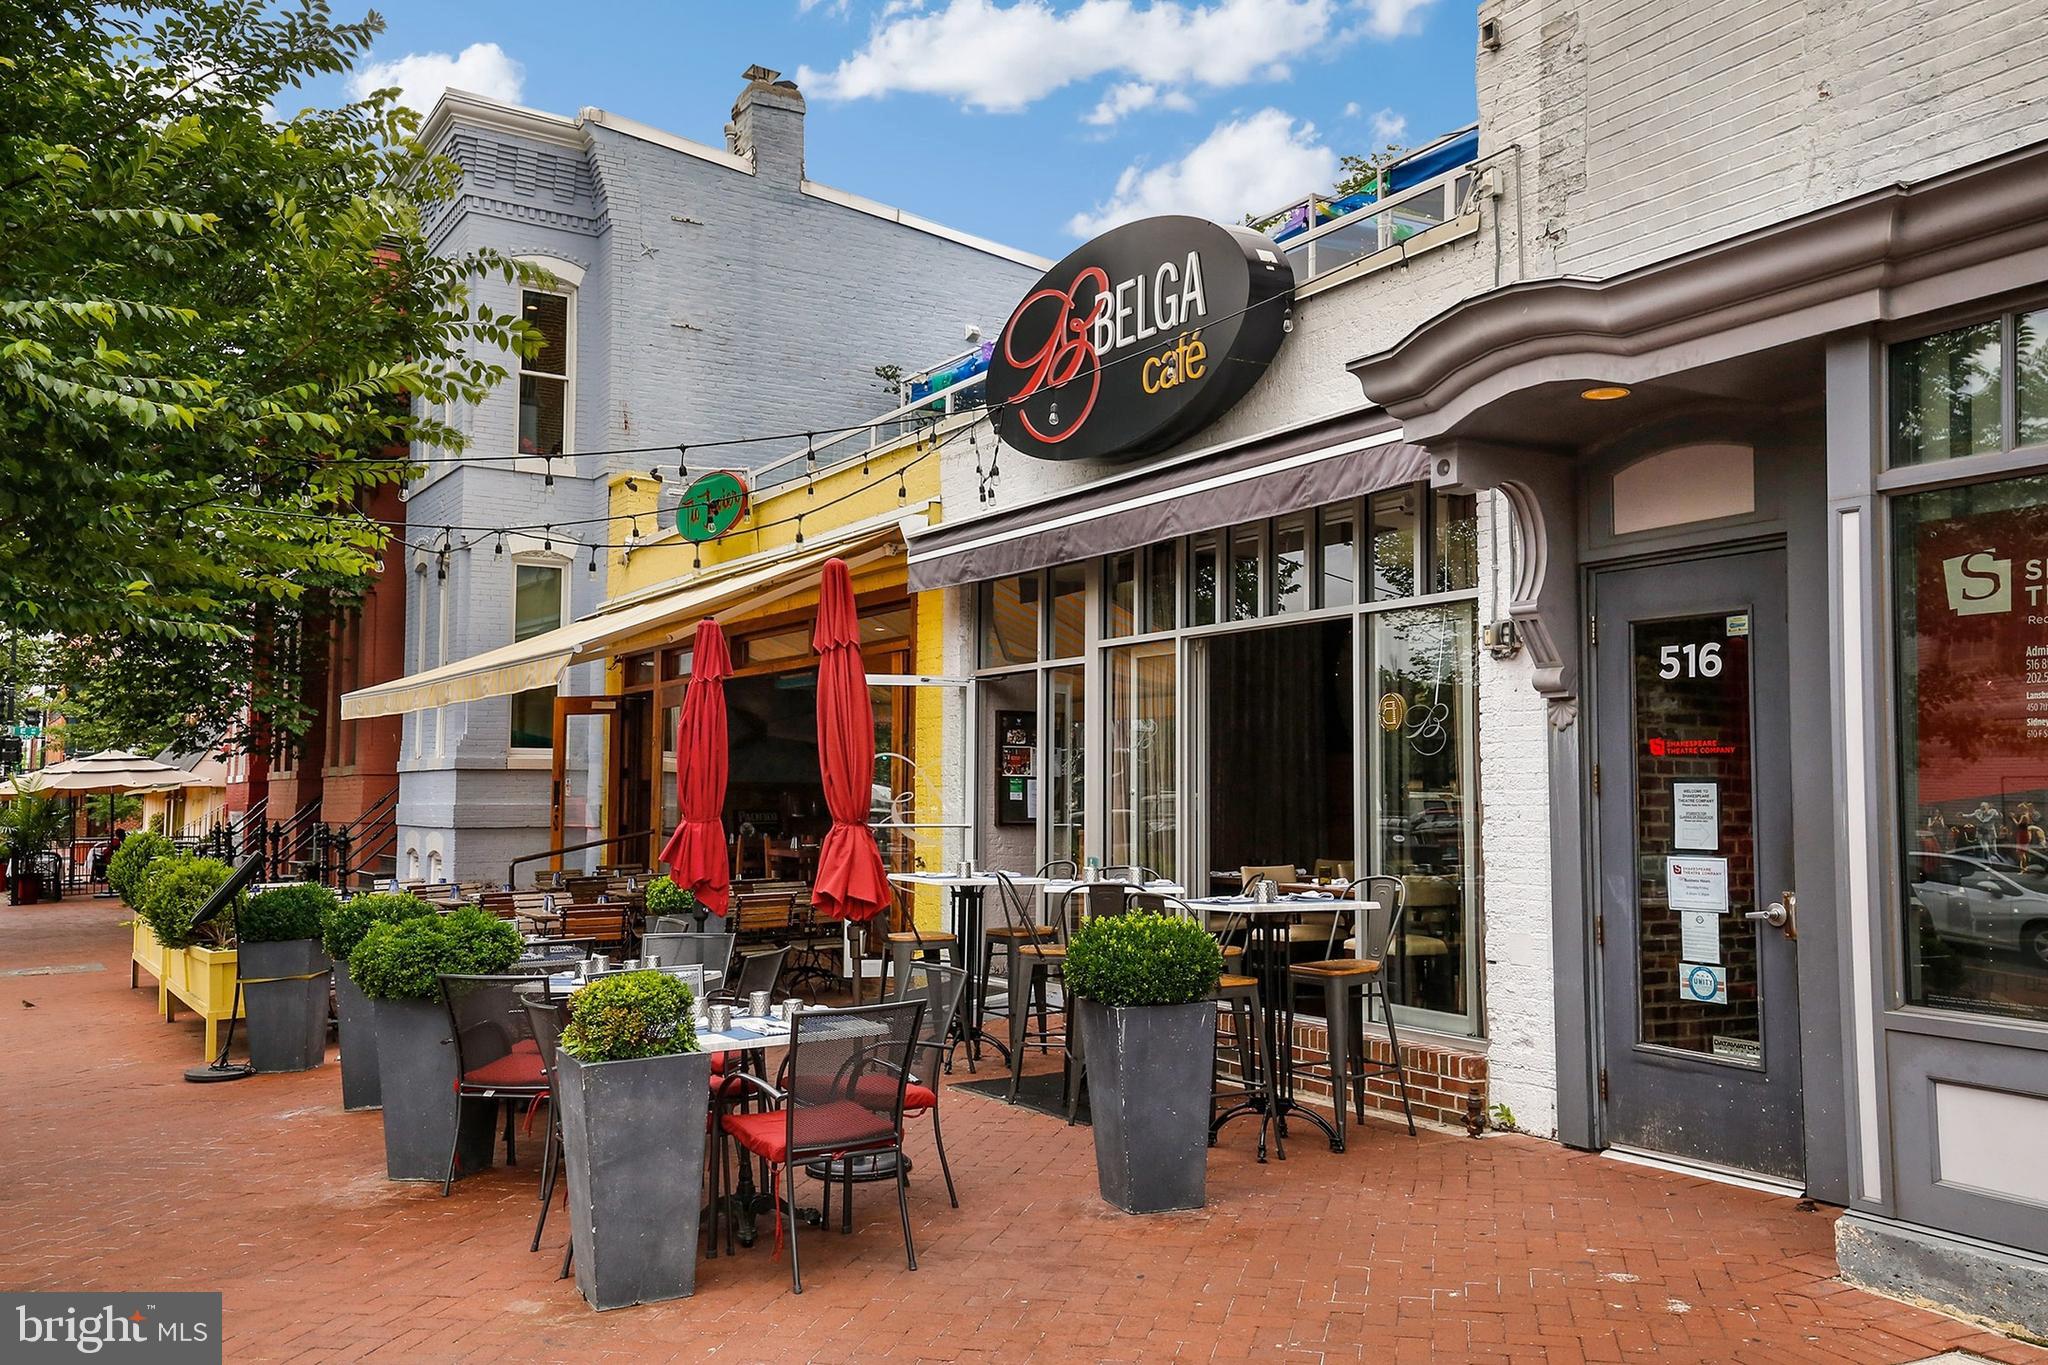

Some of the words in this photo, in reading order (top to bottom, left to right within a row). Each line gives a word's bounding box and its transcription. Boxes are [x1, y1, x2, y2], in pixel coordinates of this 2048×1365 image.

[1094, 250, 1208, 356] BELGA
[1142, 328, 1208, 395] café
[2025, 558, 2048, 581] S
[2025, 585, 2048, 607] T
[1658, 642, 1723, 680] 516
[2026, 659, 2040, 670] 516
[1700, 746, 1735, 754] COMPANY
[1694, 978, 1712, 986] UNITY
